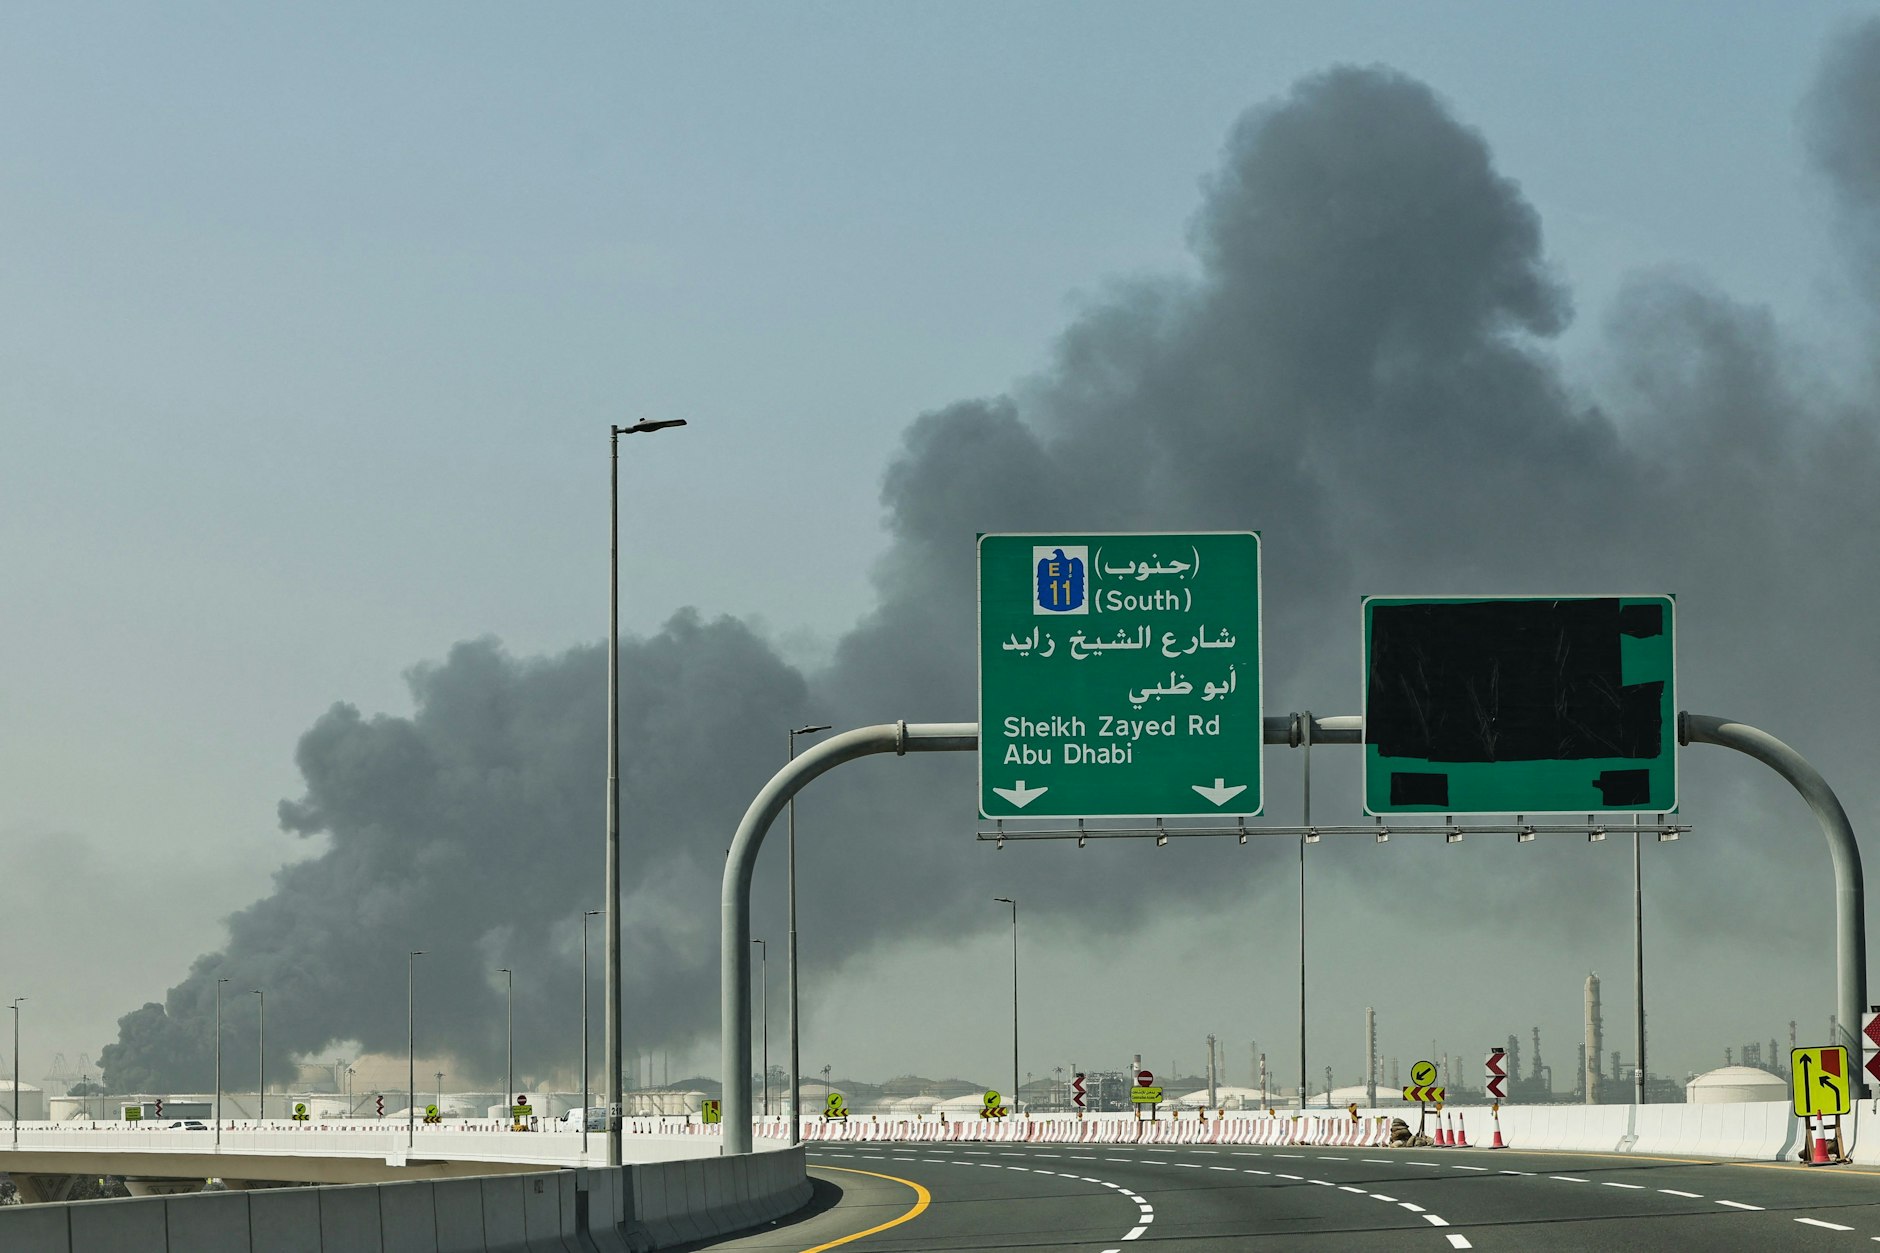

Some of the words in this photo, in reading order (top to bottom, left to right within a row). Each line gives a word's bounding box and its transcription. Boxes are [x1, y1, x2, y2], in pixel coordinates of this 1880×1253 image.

[1048, 562, 1060, 577] E
[1094, 545, 1200, 581] (جنوب)
[1049, 580, 1071, 606] 11
[1094, 587, 1192, 613] (South)
[1002, 625, 1056, 658] زايد
[1069, 624, 1151, 661] الشيخ
[1161, 624, 1236, 658] شارع
[1128, 670, 1194, 710] ظبي
[1201, 664, 1237, 702] أبو
[1003, 715, 1086, 738] Sheikh
[1098, 715, 1176, 741] Zayed
[1188, 714, 1220, 736] Rd
[1003, 743, 1052, 765] Abu
[1064, 742, 1132, 765] Dhabi
